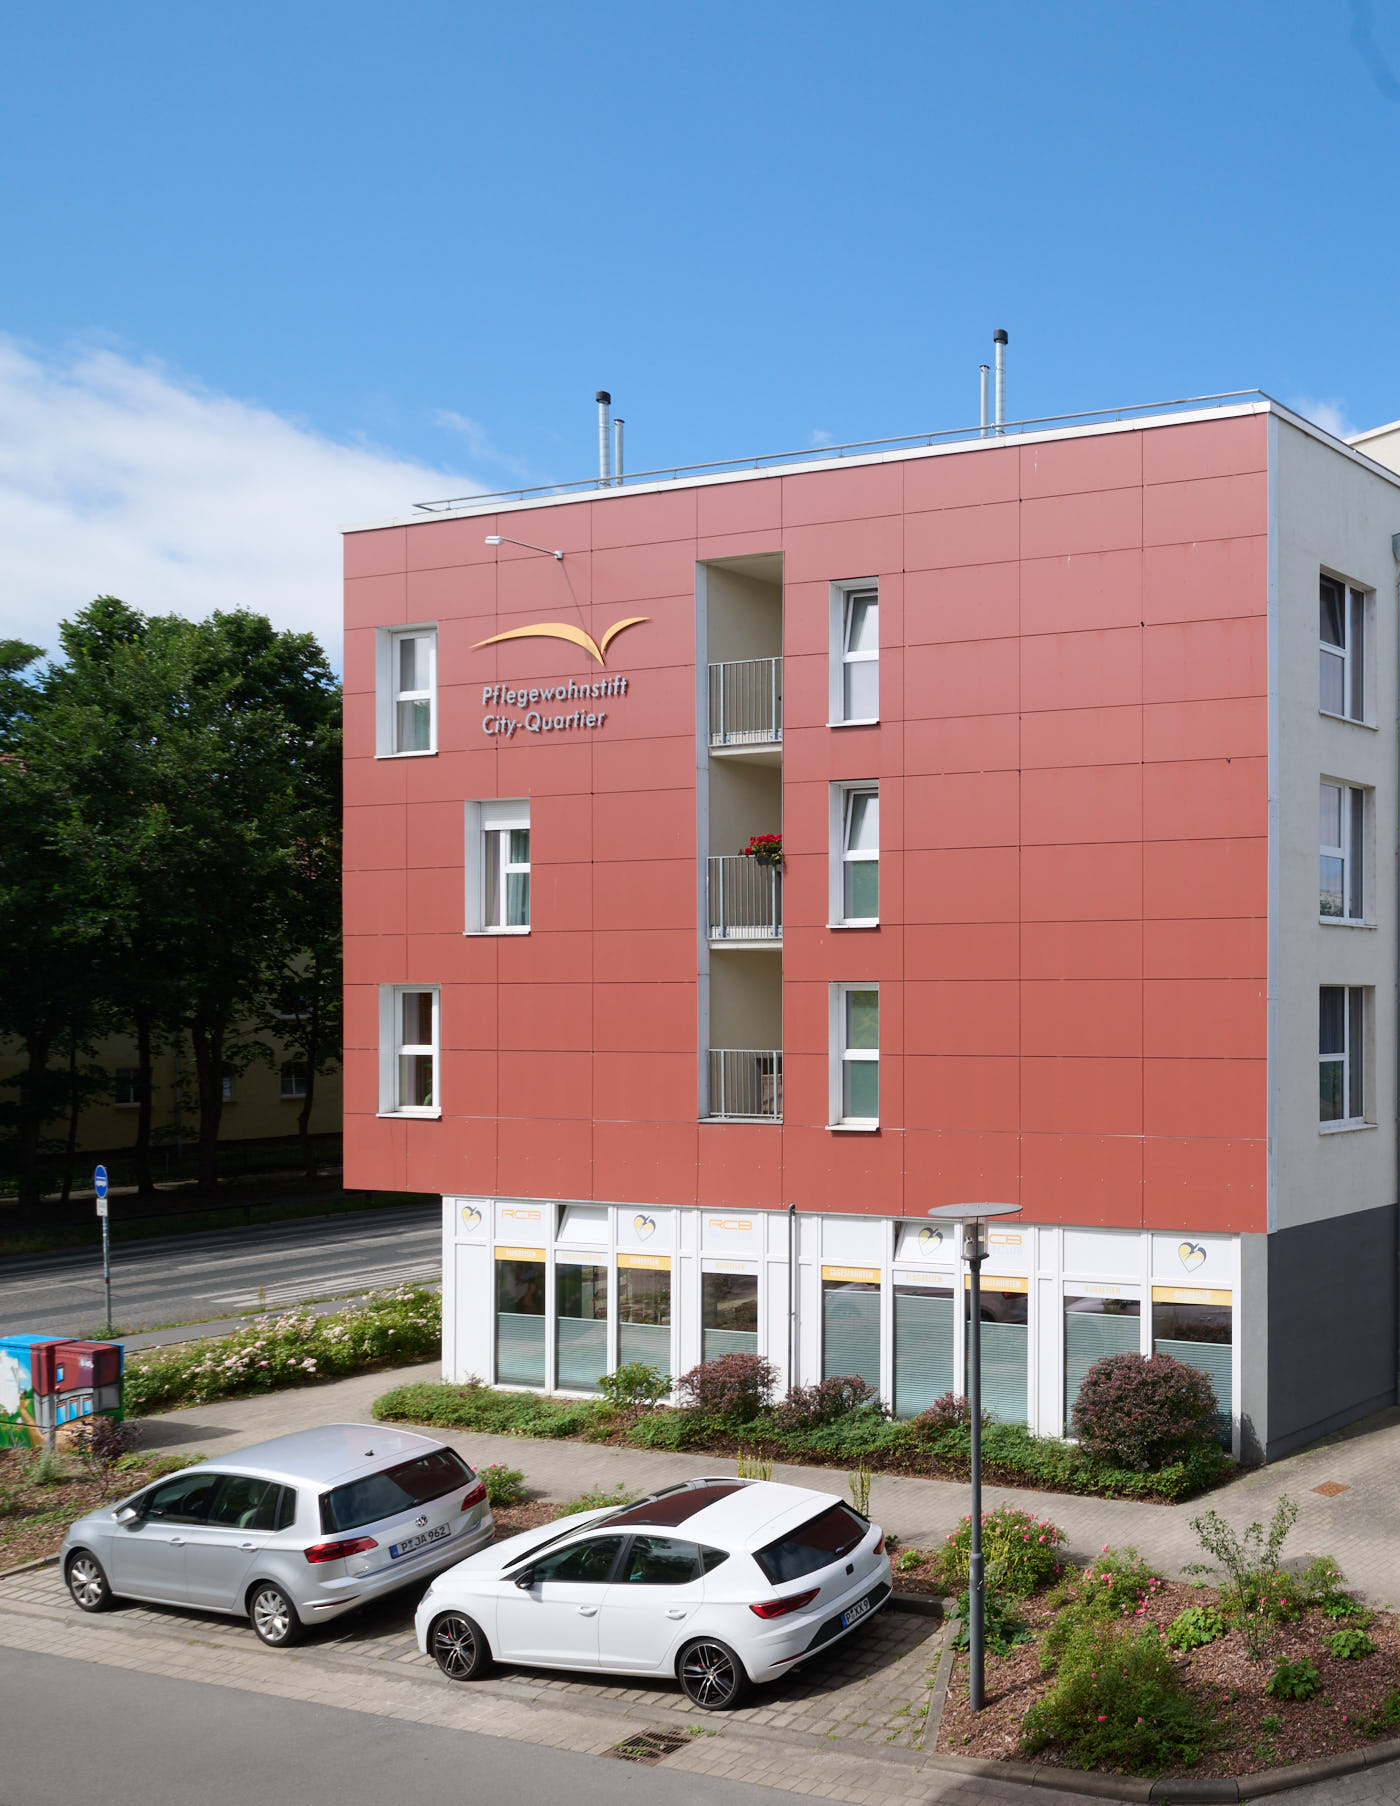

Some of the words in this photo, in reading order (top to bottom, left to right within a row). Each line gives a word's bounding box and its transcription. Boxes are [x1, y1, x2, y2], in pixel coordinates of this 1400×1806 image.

[482, 674, 628, 708] Pflegewohnstift
[482, 709, 607, 737] City-Quartier
[708, 1218, 753, 1231] RCB
[986, 1233, 1022, 1246] CB
[401, 1542, 408, 1552] P
[415, 1535, 427, 1546] JA
[428, 1526, 446, 1540] 962
